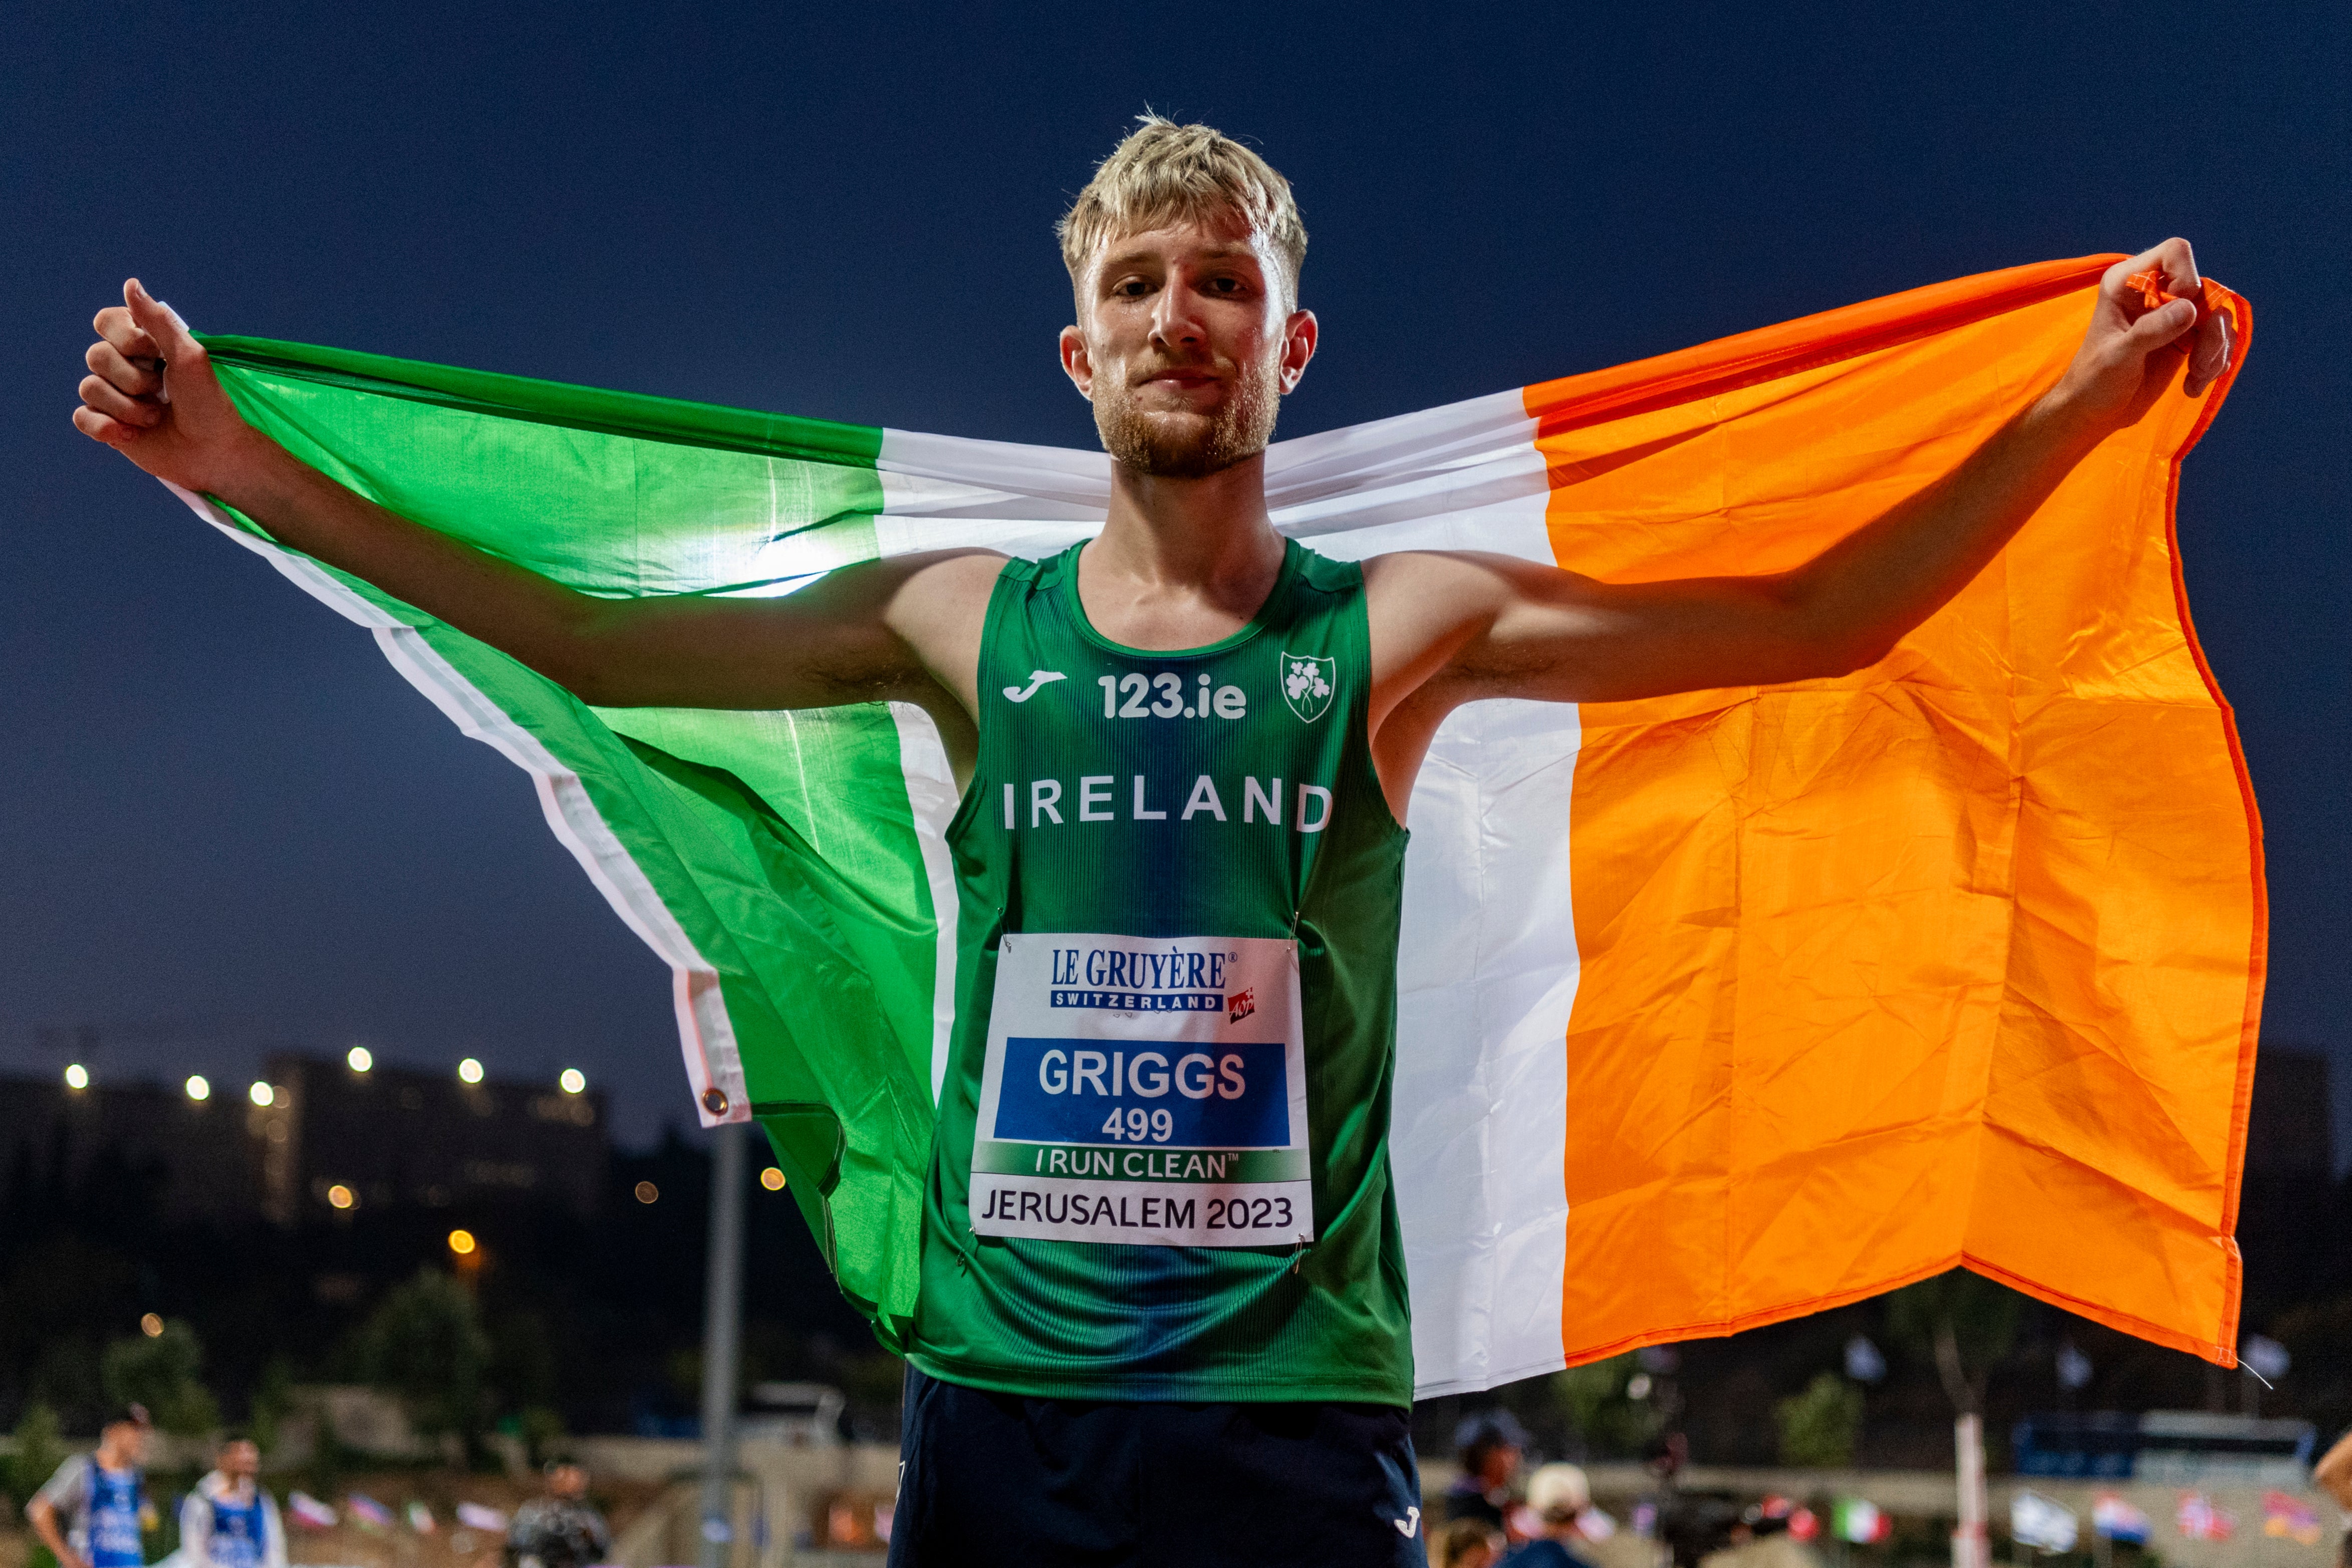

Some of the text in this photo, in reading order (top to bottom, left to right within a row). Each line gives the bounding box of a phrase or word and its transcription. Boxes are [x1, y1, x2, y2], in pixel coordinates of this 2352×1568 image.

[1098, 672, 1247, 720] 123.ie
[1003, 774, 1334, 833] IRELAND
[1051, 949, 1079, 985] LE
[1056, 992, 1216, 1009] SWITZERLAND
[1229, 998, 1254, 1017] AOP
[1039, 1049, 1246, 1100] GRIGGS
[1102, 1107, 1174, 1142] 499
[1035, 1149, 1044, 1172] I
[1049, 1149, 1115, 1176] RUN
[981, 1189, 1293, 1230] JERUSALEM 2023
